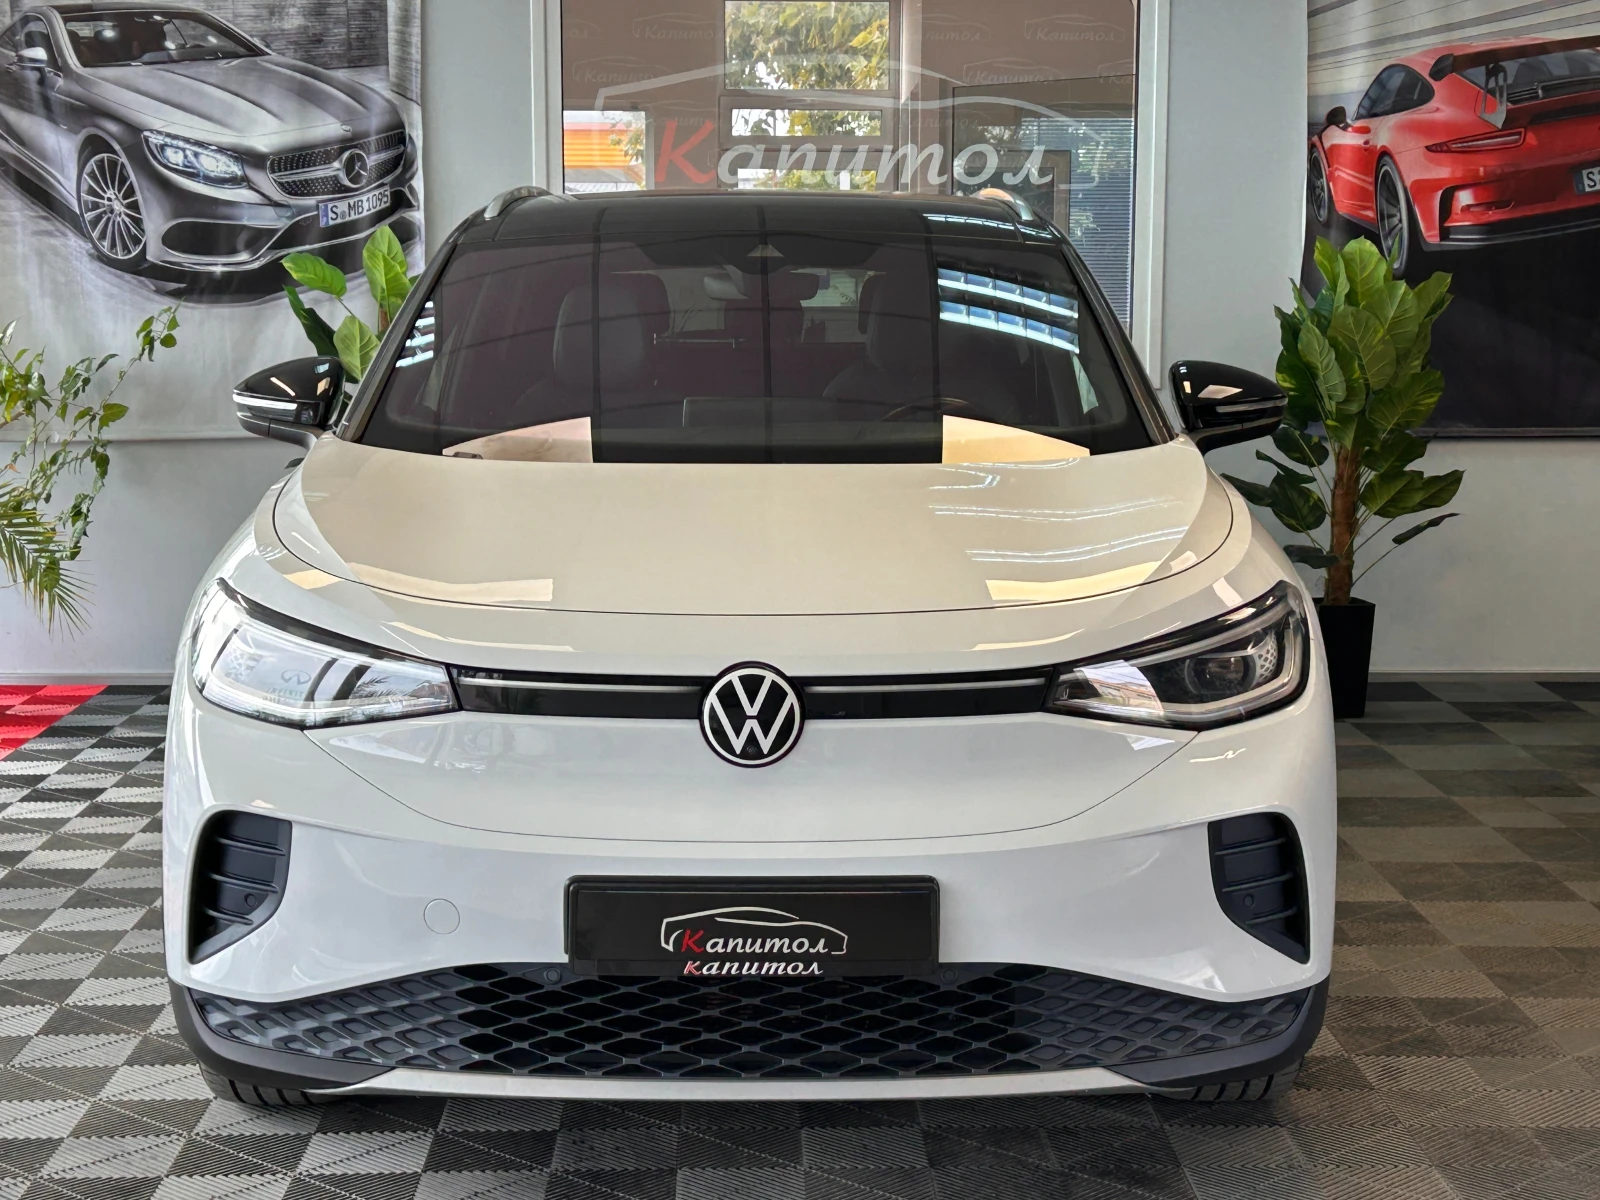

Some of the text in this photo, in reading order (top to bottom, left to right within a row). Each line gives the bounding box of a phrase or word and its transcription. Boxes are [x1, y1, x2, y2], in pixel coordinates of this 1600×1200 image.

[644, 26, 716, 41] Капито
[654, 119, 1053, 185] Капитол
[330, 190, 389, 221] S MB 1095
[681, 929, 828, 954] Капитол
